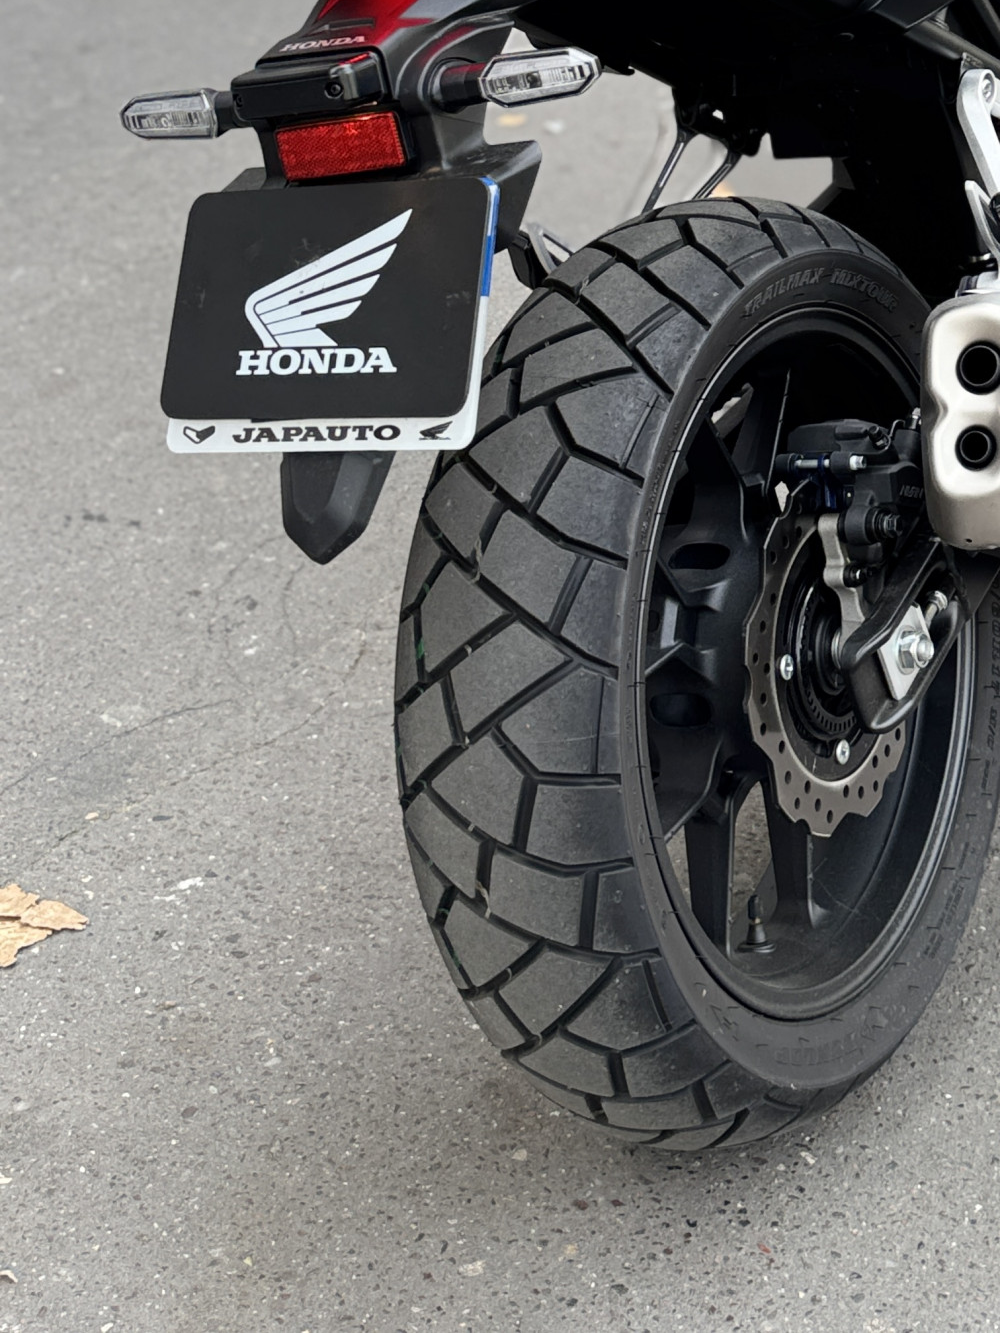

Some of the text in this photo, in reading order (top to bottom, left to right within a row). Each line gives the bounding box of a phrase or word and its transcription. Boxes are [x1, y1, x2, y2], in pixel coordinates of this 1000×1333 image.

[279, 35, 366, 52] HONDA
[743, 267, 900, 317] TRAILMAX MIXTOUR
[235, 347, 397, 375] HONDA
[232, 424, 401, 443] JAPAUTO
